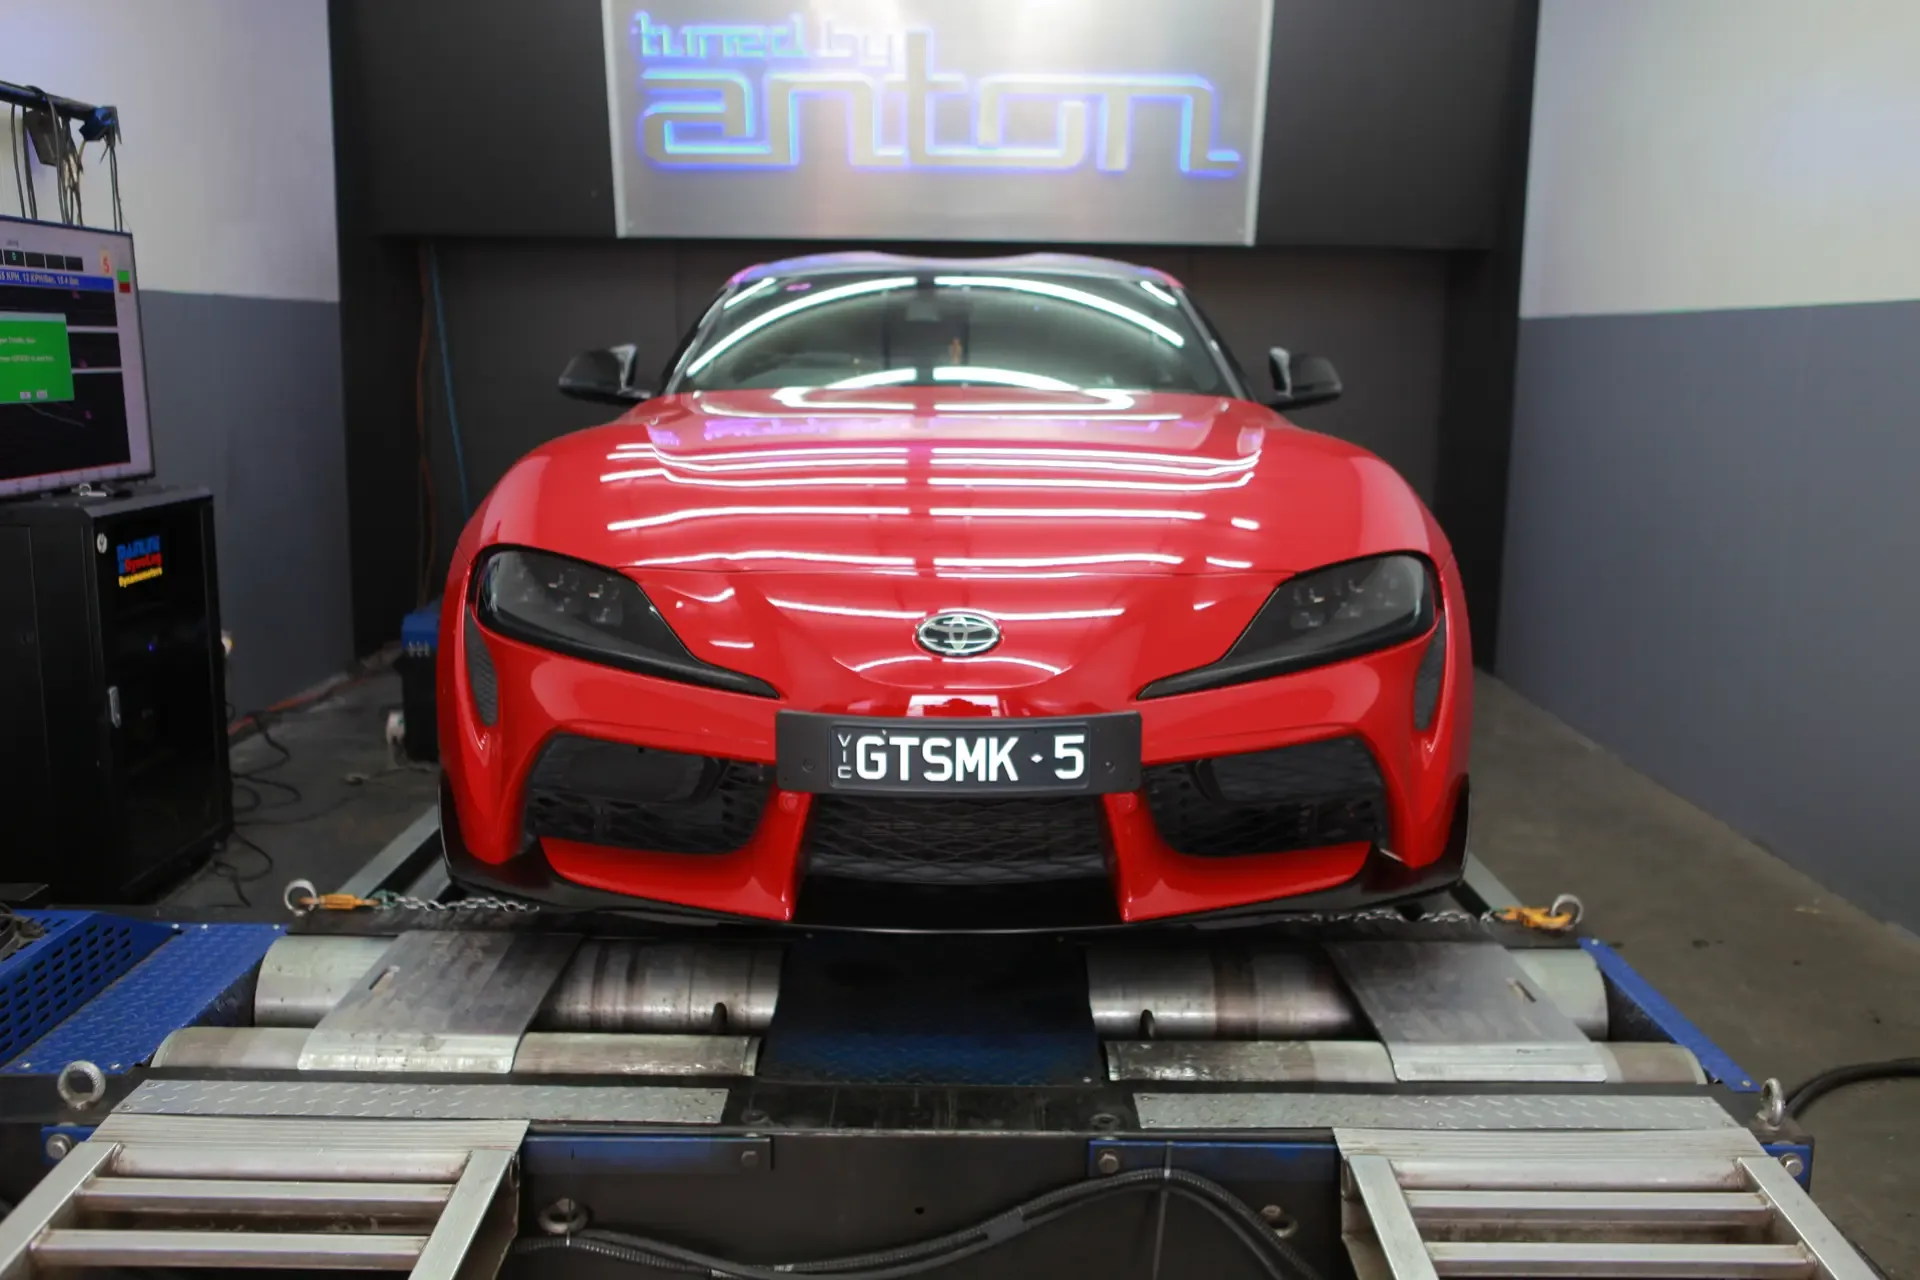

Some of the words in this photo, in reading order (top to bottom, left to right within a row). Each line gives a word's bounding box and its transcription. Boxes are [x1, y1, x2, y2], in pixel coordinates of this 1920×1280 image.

[634, 11, 806, 58] tuned
[819, 18, 897, 67] by
[641, 29, 1240, 175] anton
[837, 734, 852, 779] VIC
[856, 735, 1019, 781] GTSMK
[1054, 735, 1085, 779] 5
